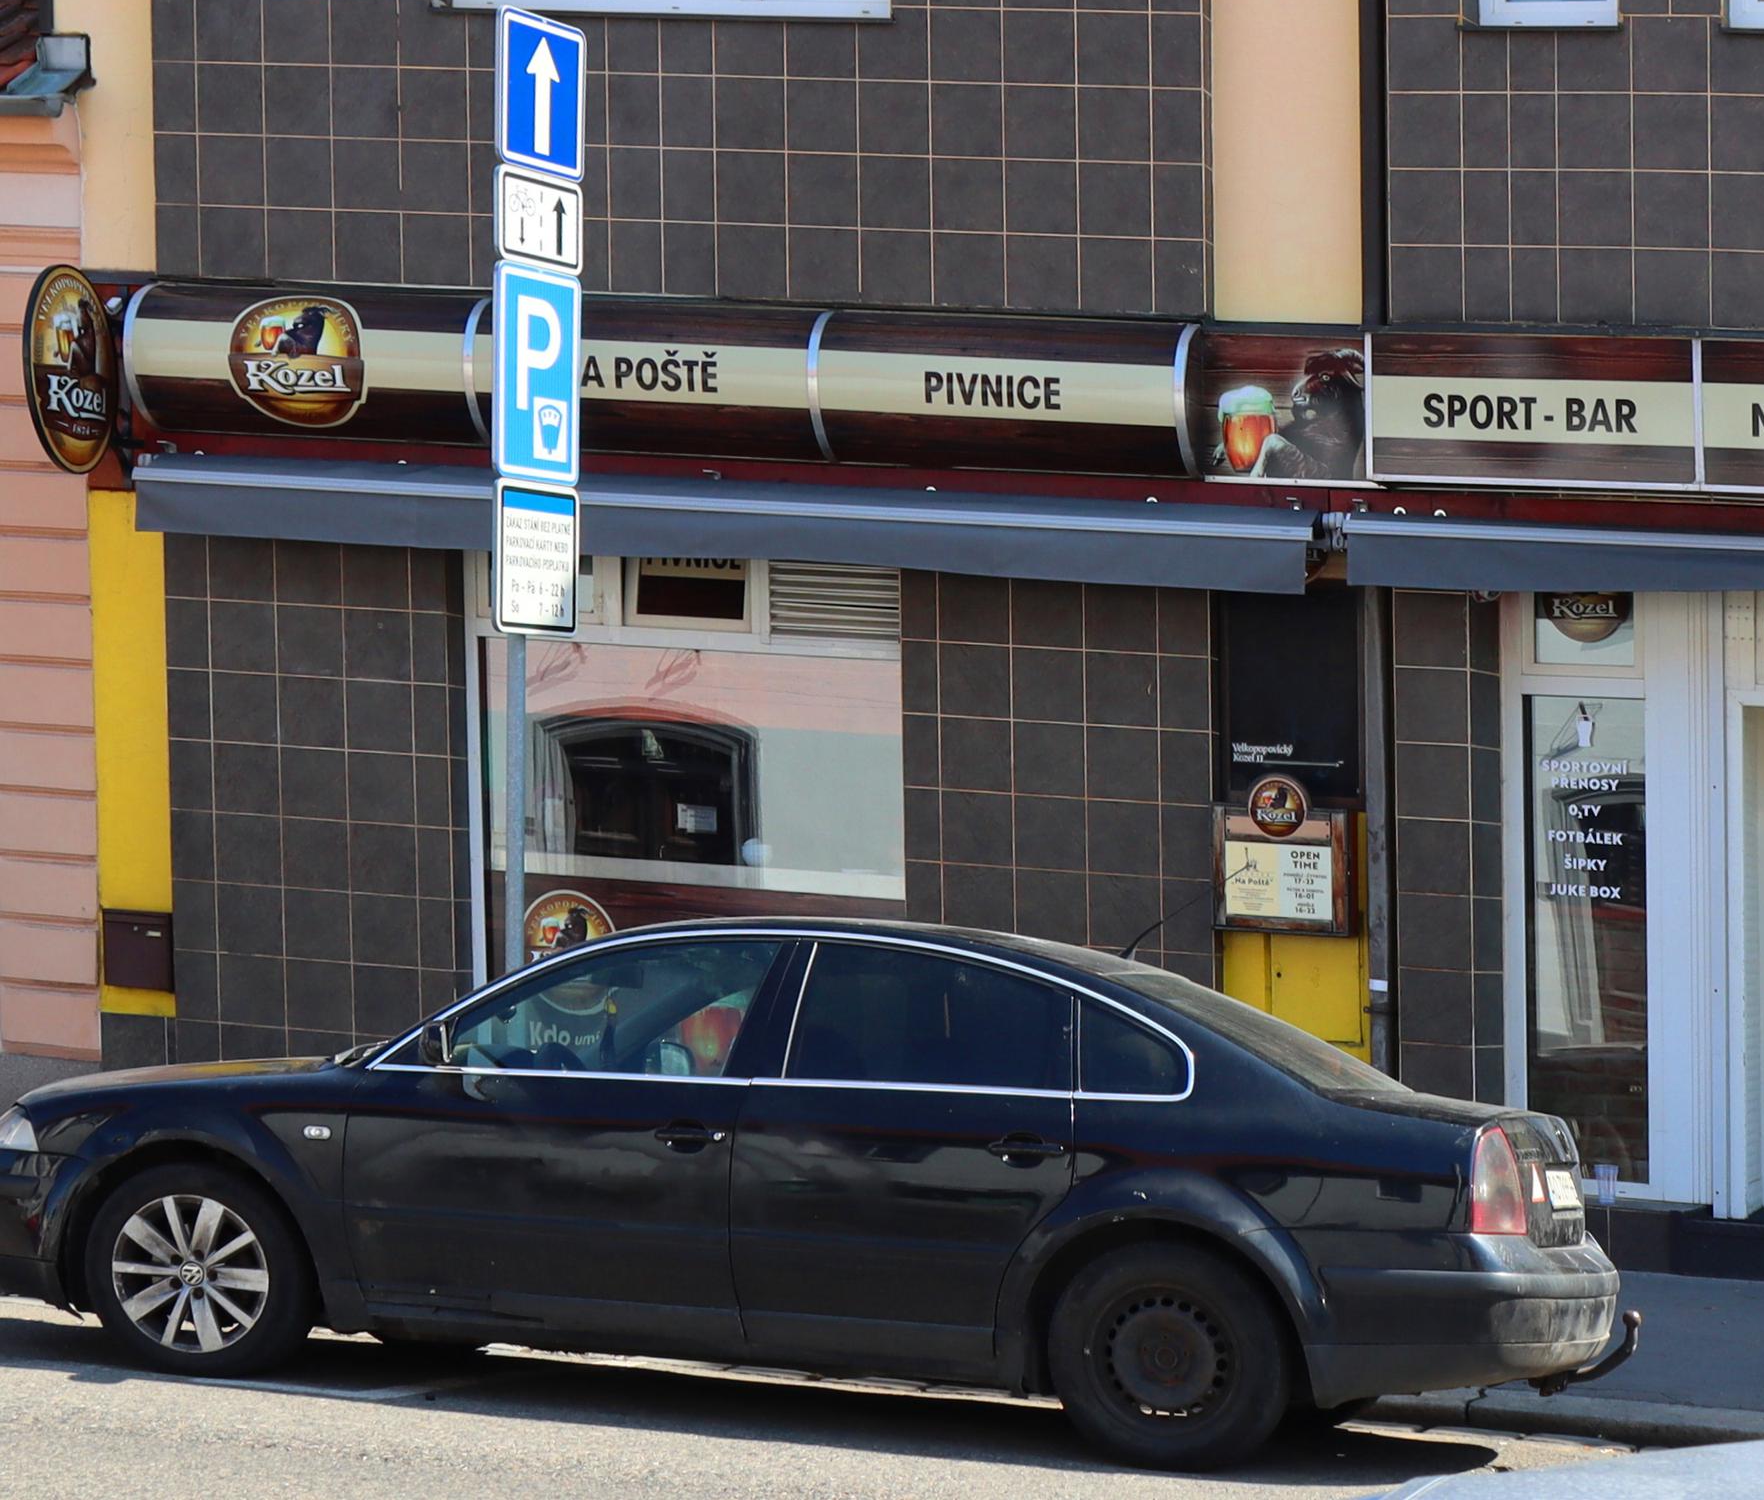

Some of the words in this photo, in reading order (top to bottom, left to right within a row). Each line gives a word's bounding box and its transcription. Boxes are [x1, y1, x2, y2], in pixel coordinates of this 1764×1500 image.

[516, 294, 561, 411] P
[243, 360, 351, 395] Kozel
[614, 350, 719, 394] POŠTĚ
[47, 374, 106, 421] Kozel
[923, 371, 1061, 411] PIVNICE
[1422, 393, 1537, 431] SPORT
[1566, 397, 1638, 433] BAR
[540, 521, 550, 534] BEZ
[536, 539, 553, 553] KARTY
[554, 541, 568, 553] NEBO
[551, 583, 559, 597] 22
[551, 603, 560, 618] 12
[1552, 597, 1618, 619] Kozel
[1232, 743, 1293, 756] Velkopopovický
[1541, 759, 1628, 775] SPORTOVNÍ
[1551, 775, 1619, 792] PŘENOSY
[1256, 809, 1297, 823] Kozel
[1548, 828, 1623, 845] FOTBÁLEK
[1291, 851, 1320, 860] OPEN
[1564, 853, 1607, 871] ŠIPKY
[1293, 861, 1318, 870] TIME
[1550, 884, 1586, 897] JUKE
[1590, 886, 1621, 899] BOX
[530, 1021, 571, 1047] Kdo
